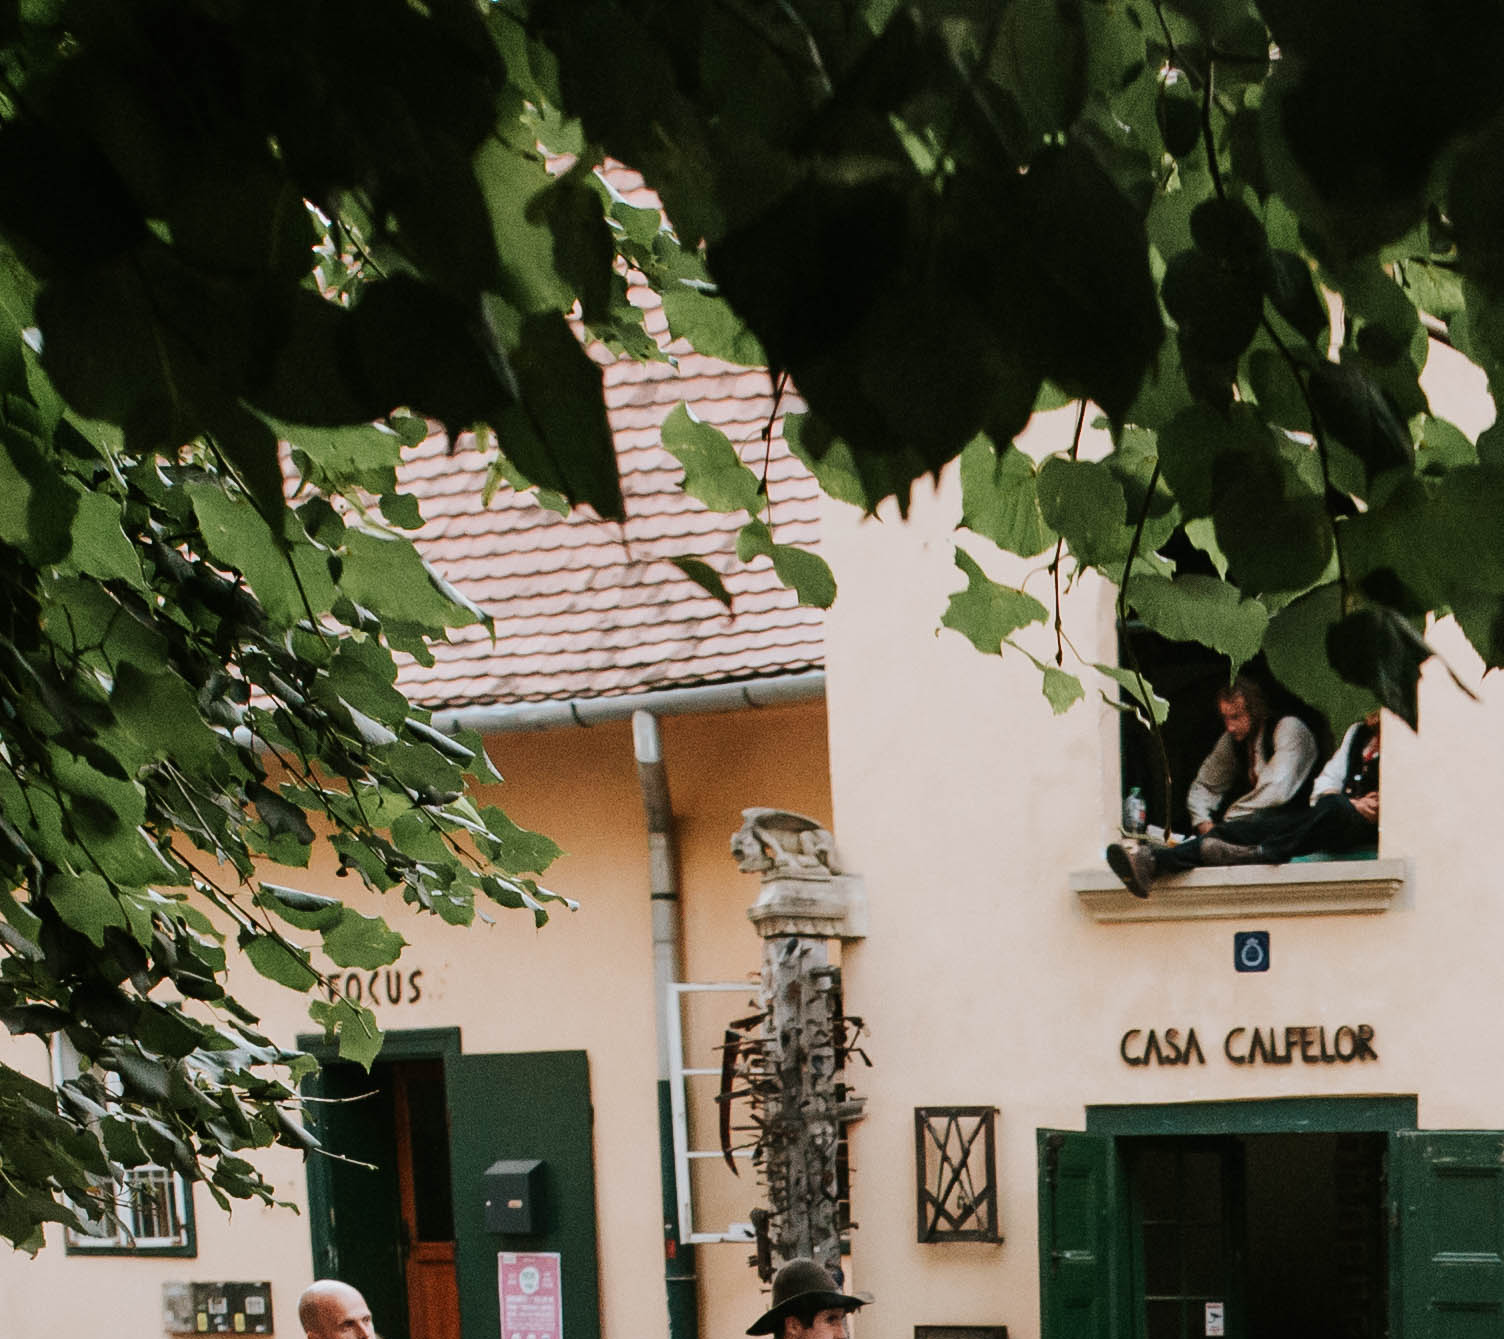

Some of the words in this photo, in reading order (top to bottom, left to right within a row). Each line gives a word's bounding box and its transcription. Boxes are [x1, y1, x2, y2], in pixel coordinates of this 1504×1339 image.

[327, 969, 422, 1006] FOCUS
[1120, 1027, 1206, 1066] CASA
[1223, 1023, 1379, 1066] CALFELOR
